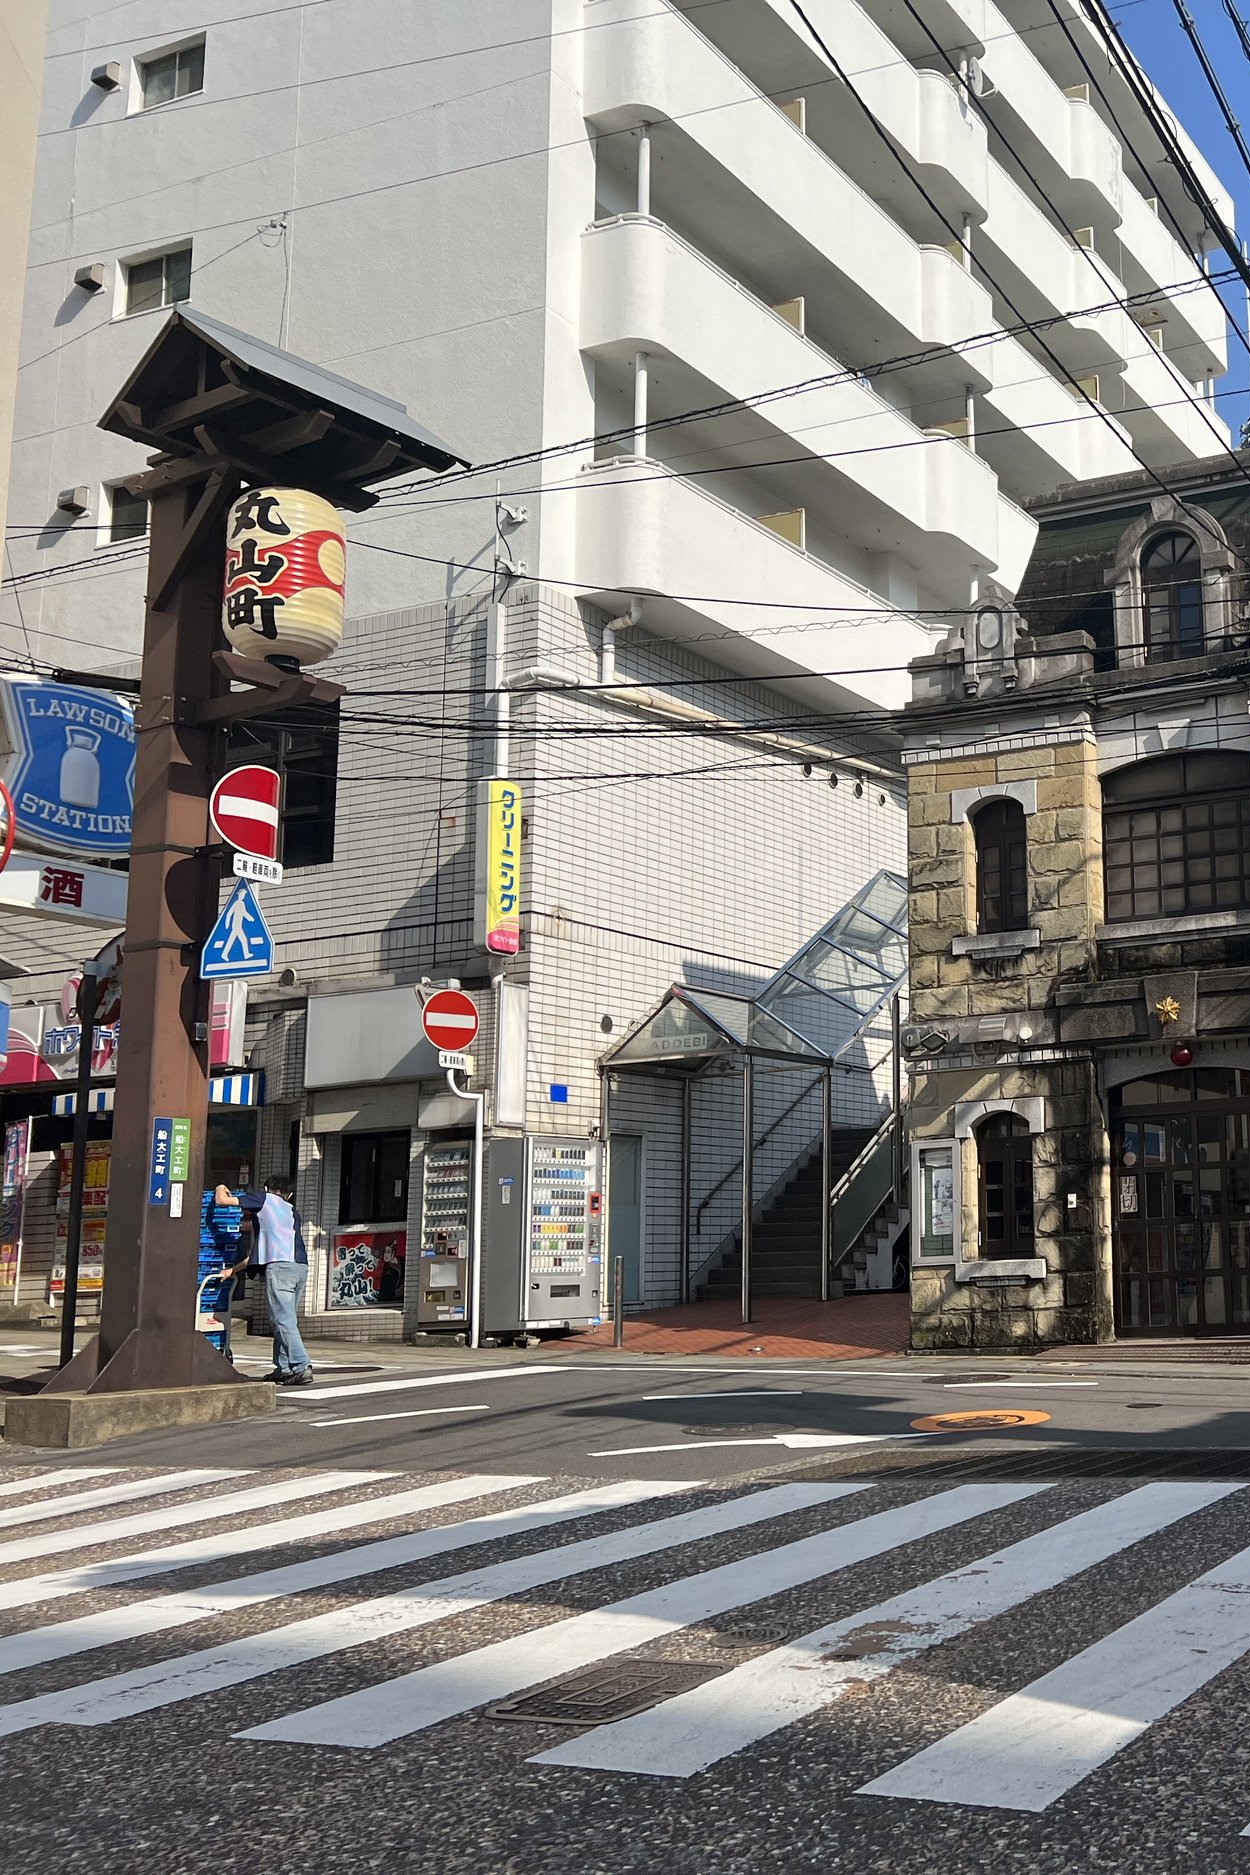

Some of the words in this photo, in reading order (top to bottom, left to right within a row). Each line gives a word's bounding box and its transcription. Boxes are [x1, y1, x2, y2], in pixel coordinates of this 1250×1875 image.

[227, 491, 291, 640] 丸山町
[26, 697, 136, 745] LAWSON
[20, 792, 132, 834] STATION
[500, 788, 517, 914] クリーニング
[40, 865, 85, 908] 酒
[43, 1021, 120, 1056] ホワト
[155, 1129, 168, 1175] 船大工町
[154, 1187, 163, 1199] 4
